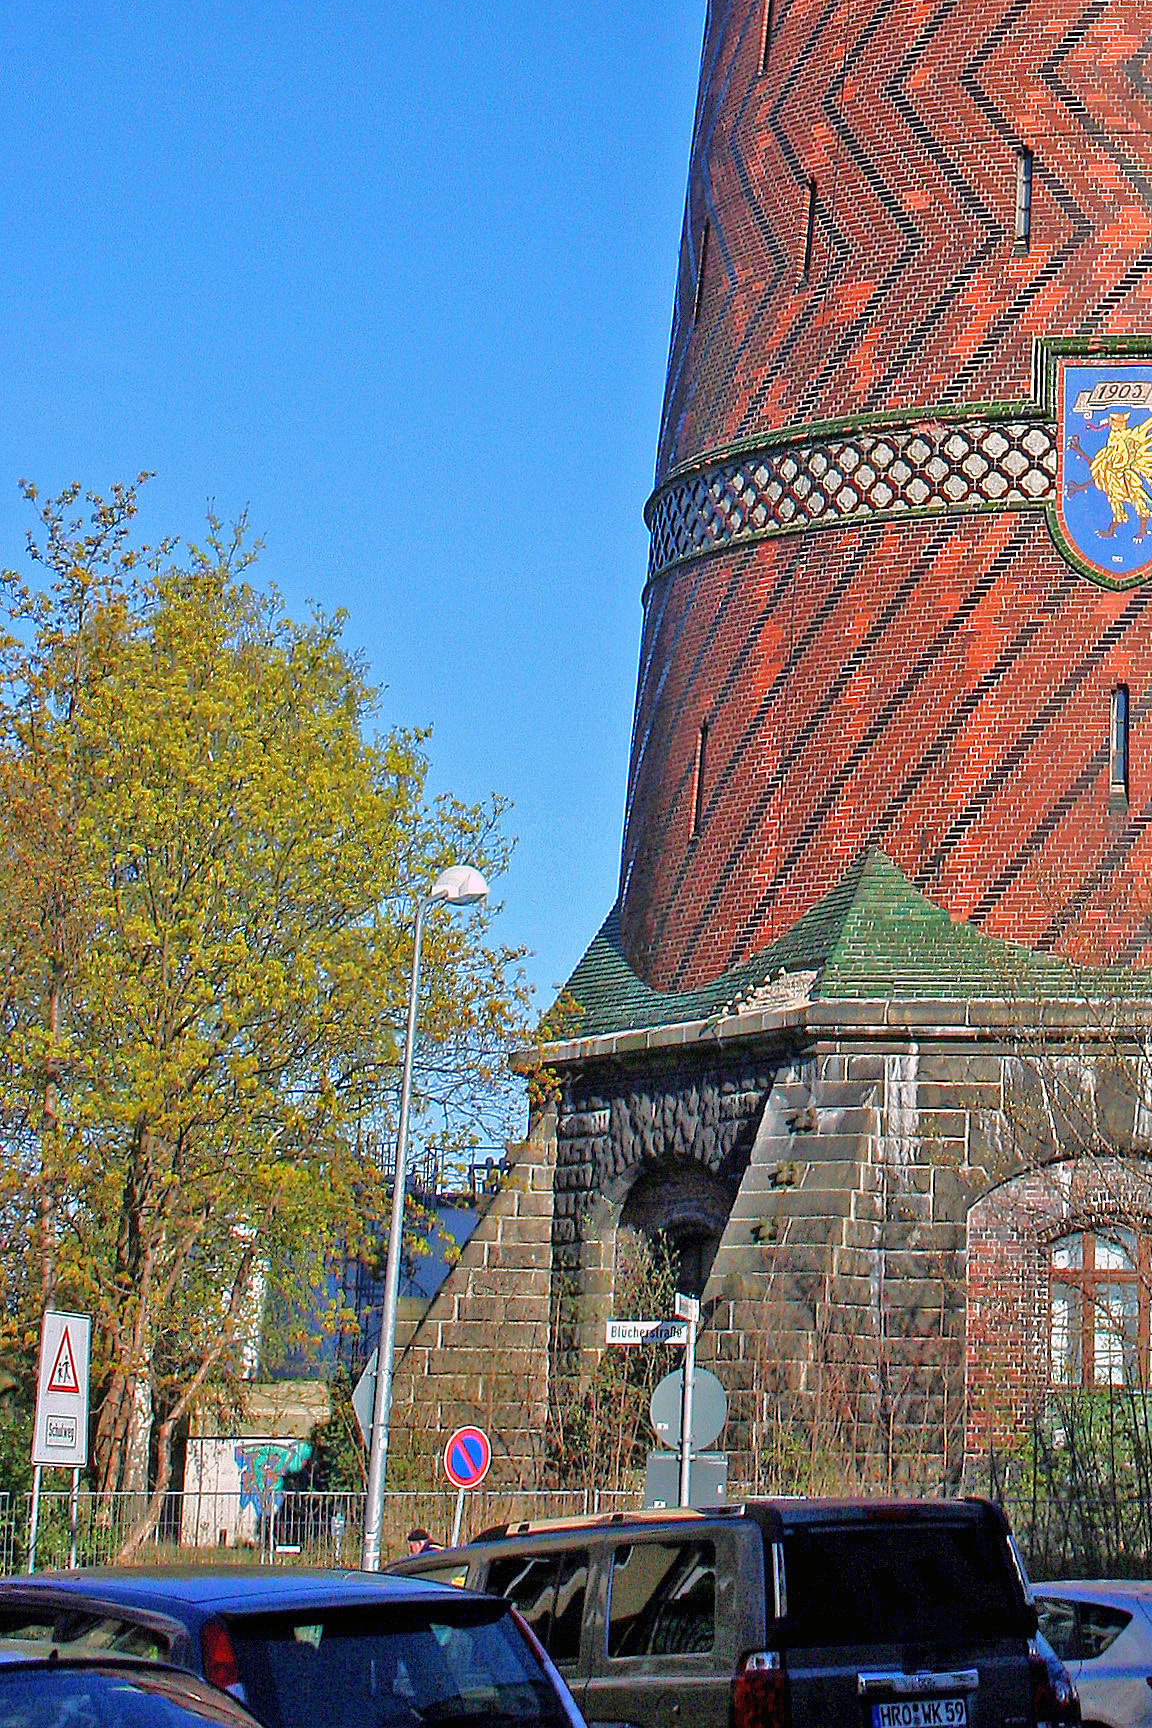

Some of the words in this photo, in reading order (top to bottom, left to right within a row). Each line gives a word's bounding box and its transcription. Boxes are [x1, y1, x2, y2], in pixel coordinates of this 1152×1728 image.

[1098, 384, 1143, 399] 1903
[611, 1325, 683, 1339] Blücherstraße
[880, 1705, 912, 1726] HRO
[922, 1702, 942, 1724] WK
[945, 1701, 963, 1722] 59
